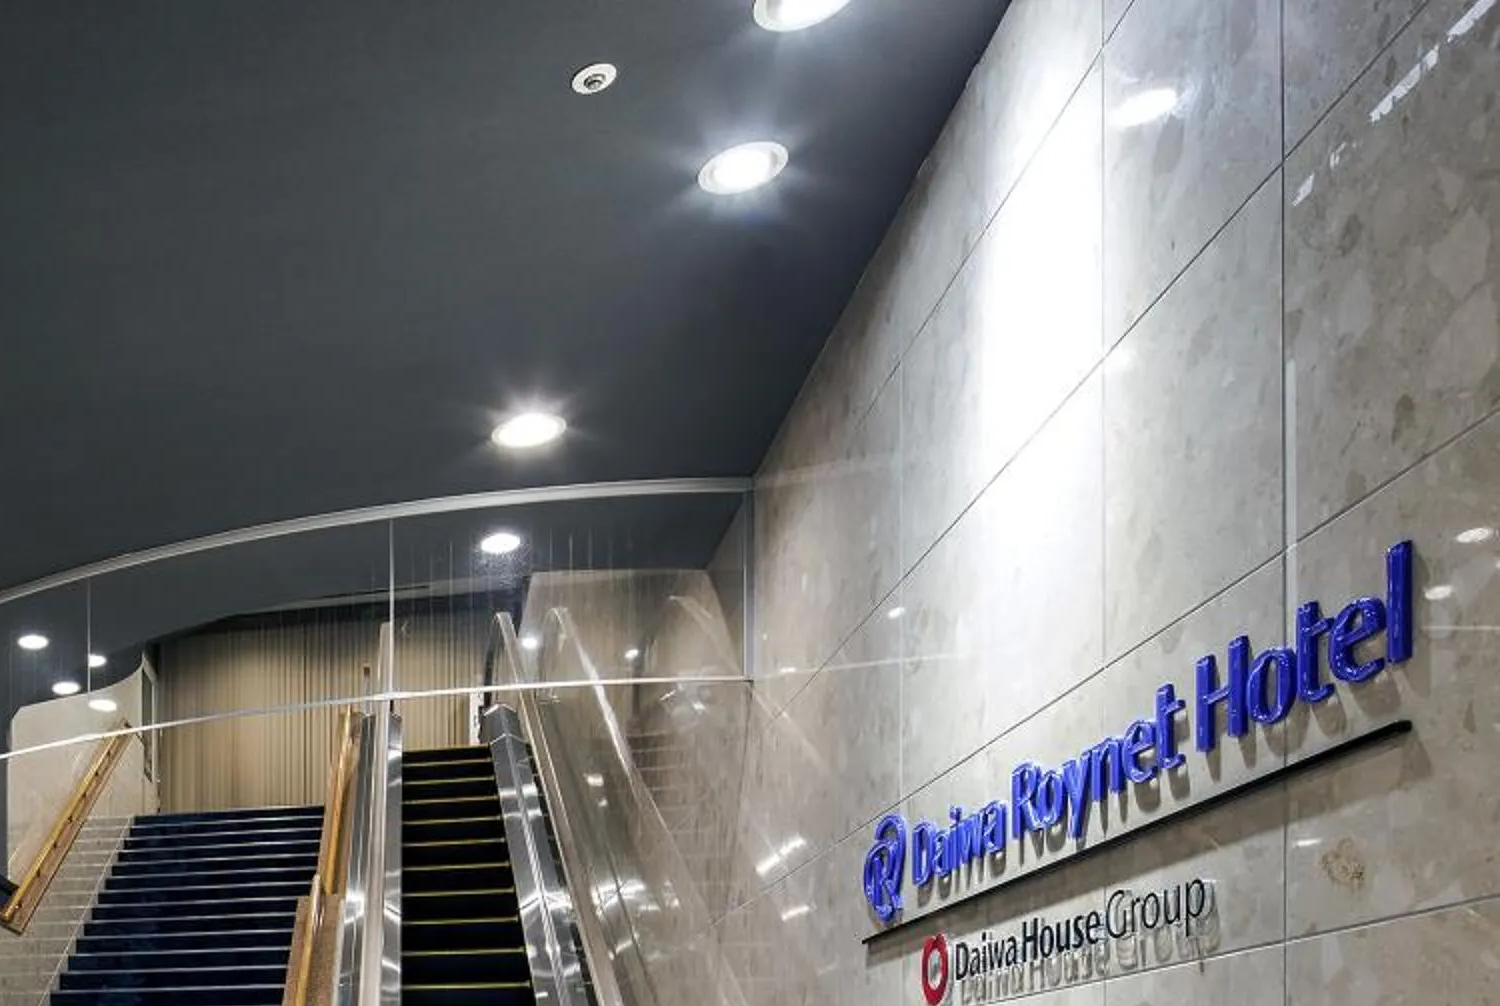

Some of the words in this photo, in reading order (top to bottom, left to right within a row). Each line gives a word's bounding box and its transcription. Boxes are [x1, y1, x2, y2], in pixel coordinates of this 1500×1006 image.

[912, 800, 1006, 887] Daiwa
[1011, 683, 1186, 840] Roynet
[1195, 540, 1413, 752] Hotel
[1106, 877, 1205, 938] Group
